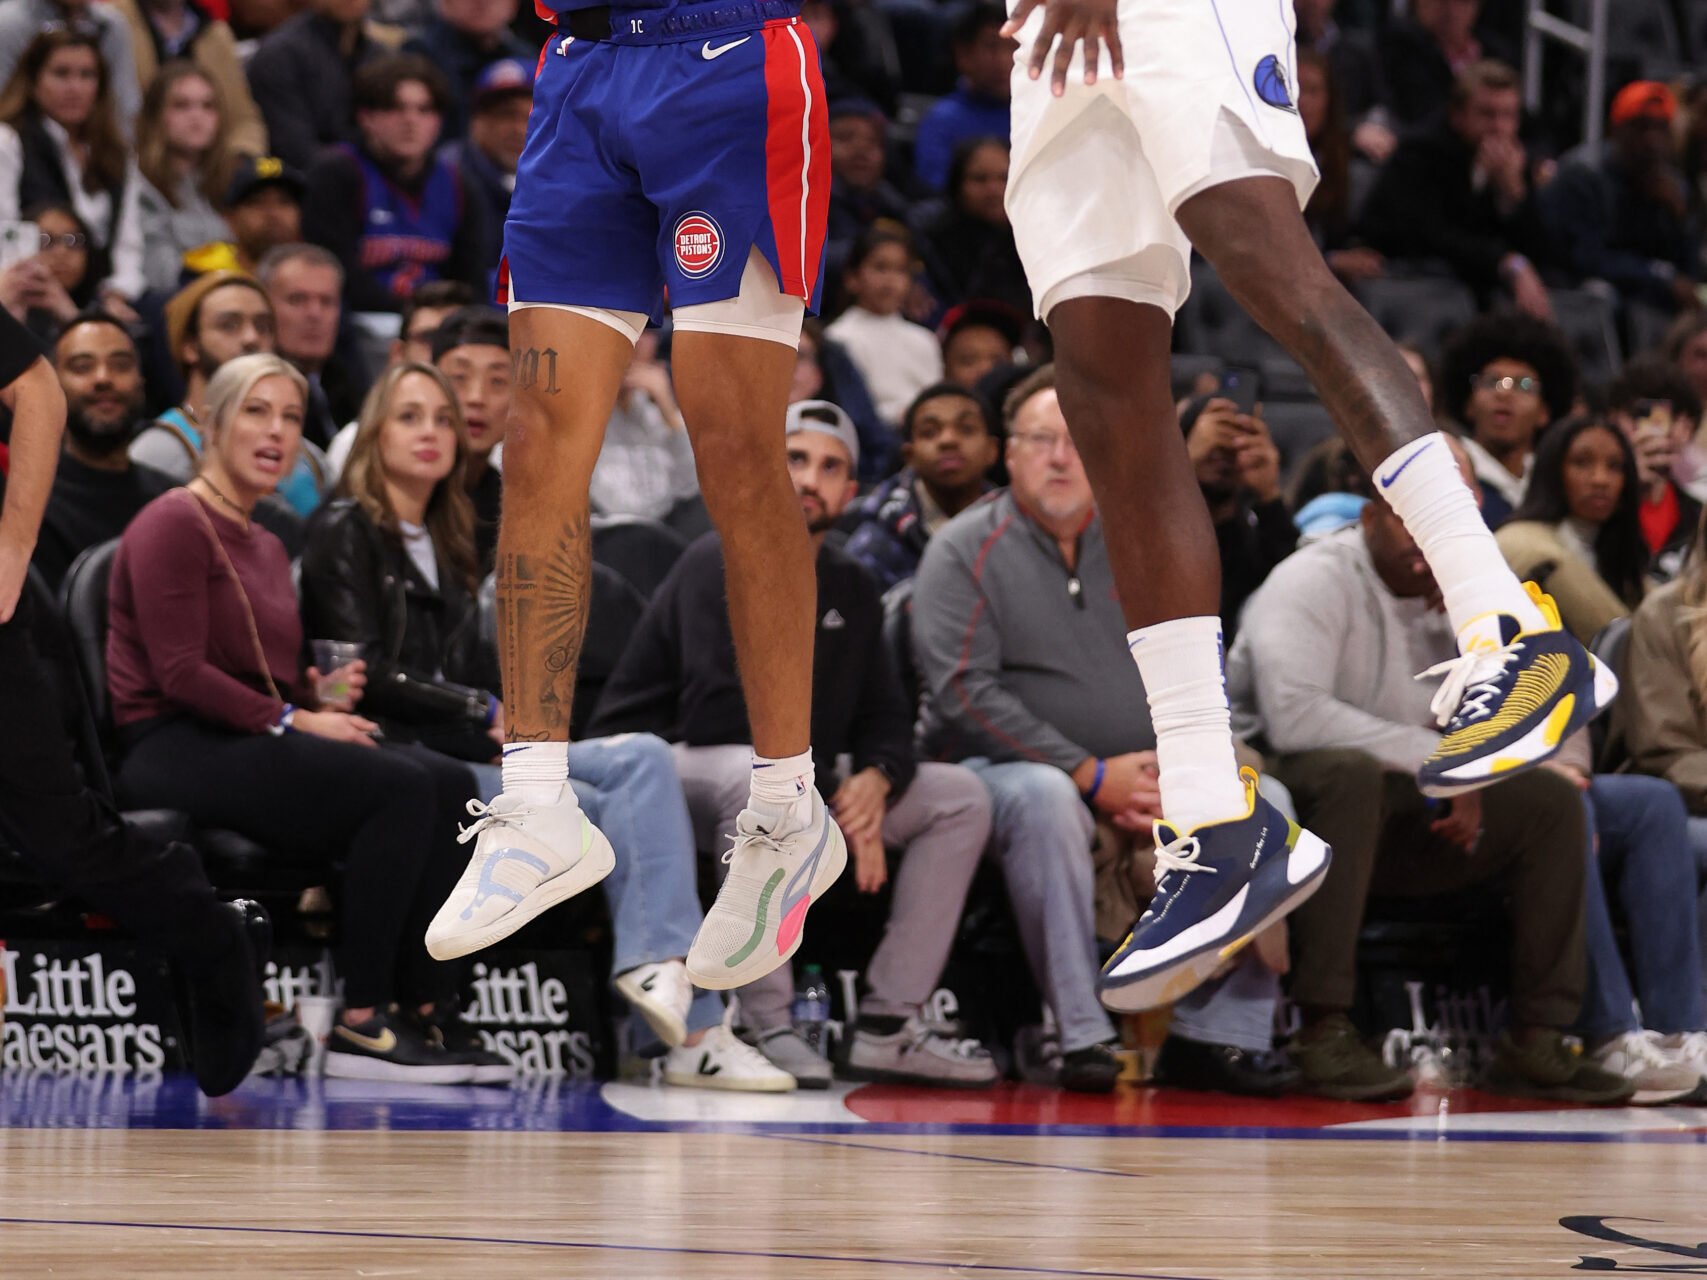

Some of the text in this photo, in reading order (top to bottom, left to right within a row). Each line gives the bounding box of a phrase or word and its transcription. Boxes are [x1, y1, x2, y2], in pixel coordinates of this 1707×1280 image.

[680, 233, 712, 245] DETROIT
[680, 244, 713, 256] PISTONS
[3, 950, 137, 1017] Little
[2, 1021, 165, 1070] aesars
